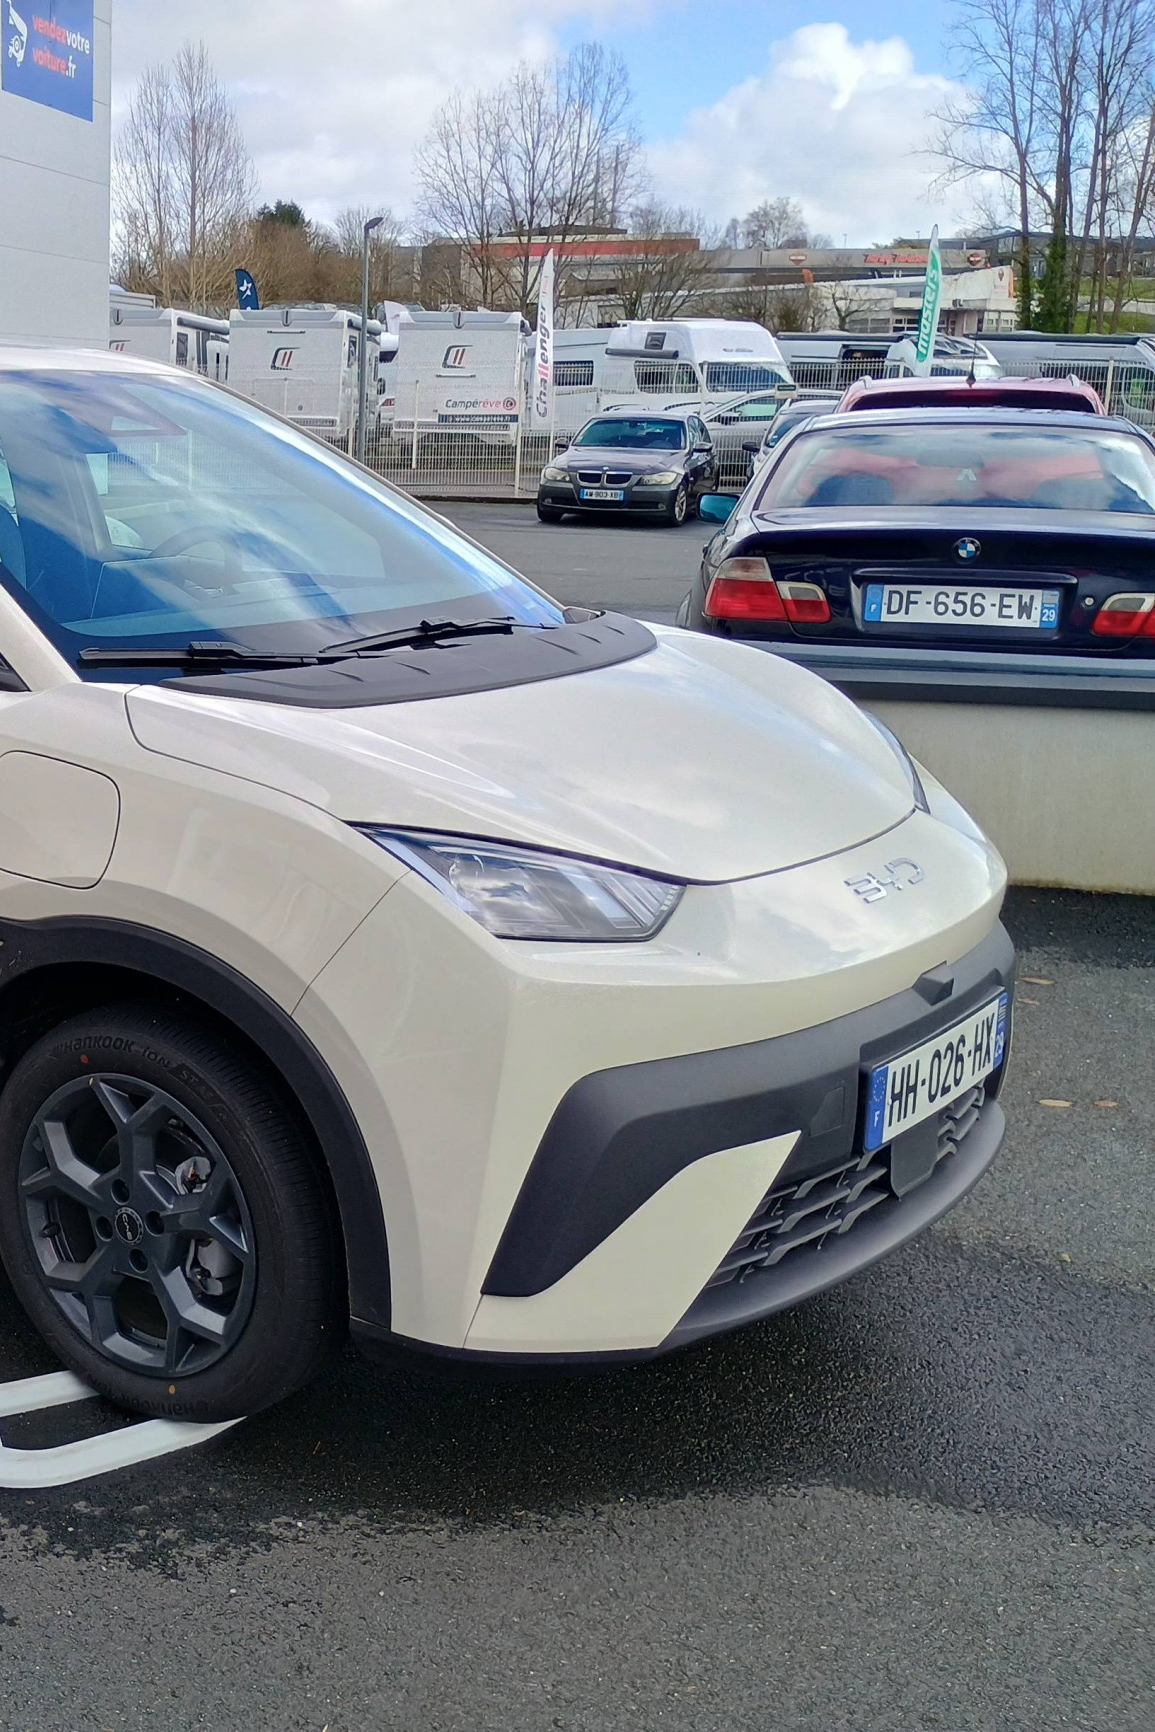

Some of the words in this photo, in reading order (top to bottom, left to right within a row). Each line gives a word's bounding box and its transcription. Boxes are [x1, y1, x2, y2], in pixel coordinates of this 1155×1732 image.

[31, 14, 90, 54] vendezvotre
[31, 46, 77, 79] voiture.fr
[536, 305, 551, 418] Challenger
[886, 589, 1035, 620] DF-656-EW
[1041, 608, 1056, 622] 29
[844, 857, 925, 904] BYD
[887, 1012, 995, 1128] HH-026-HX
